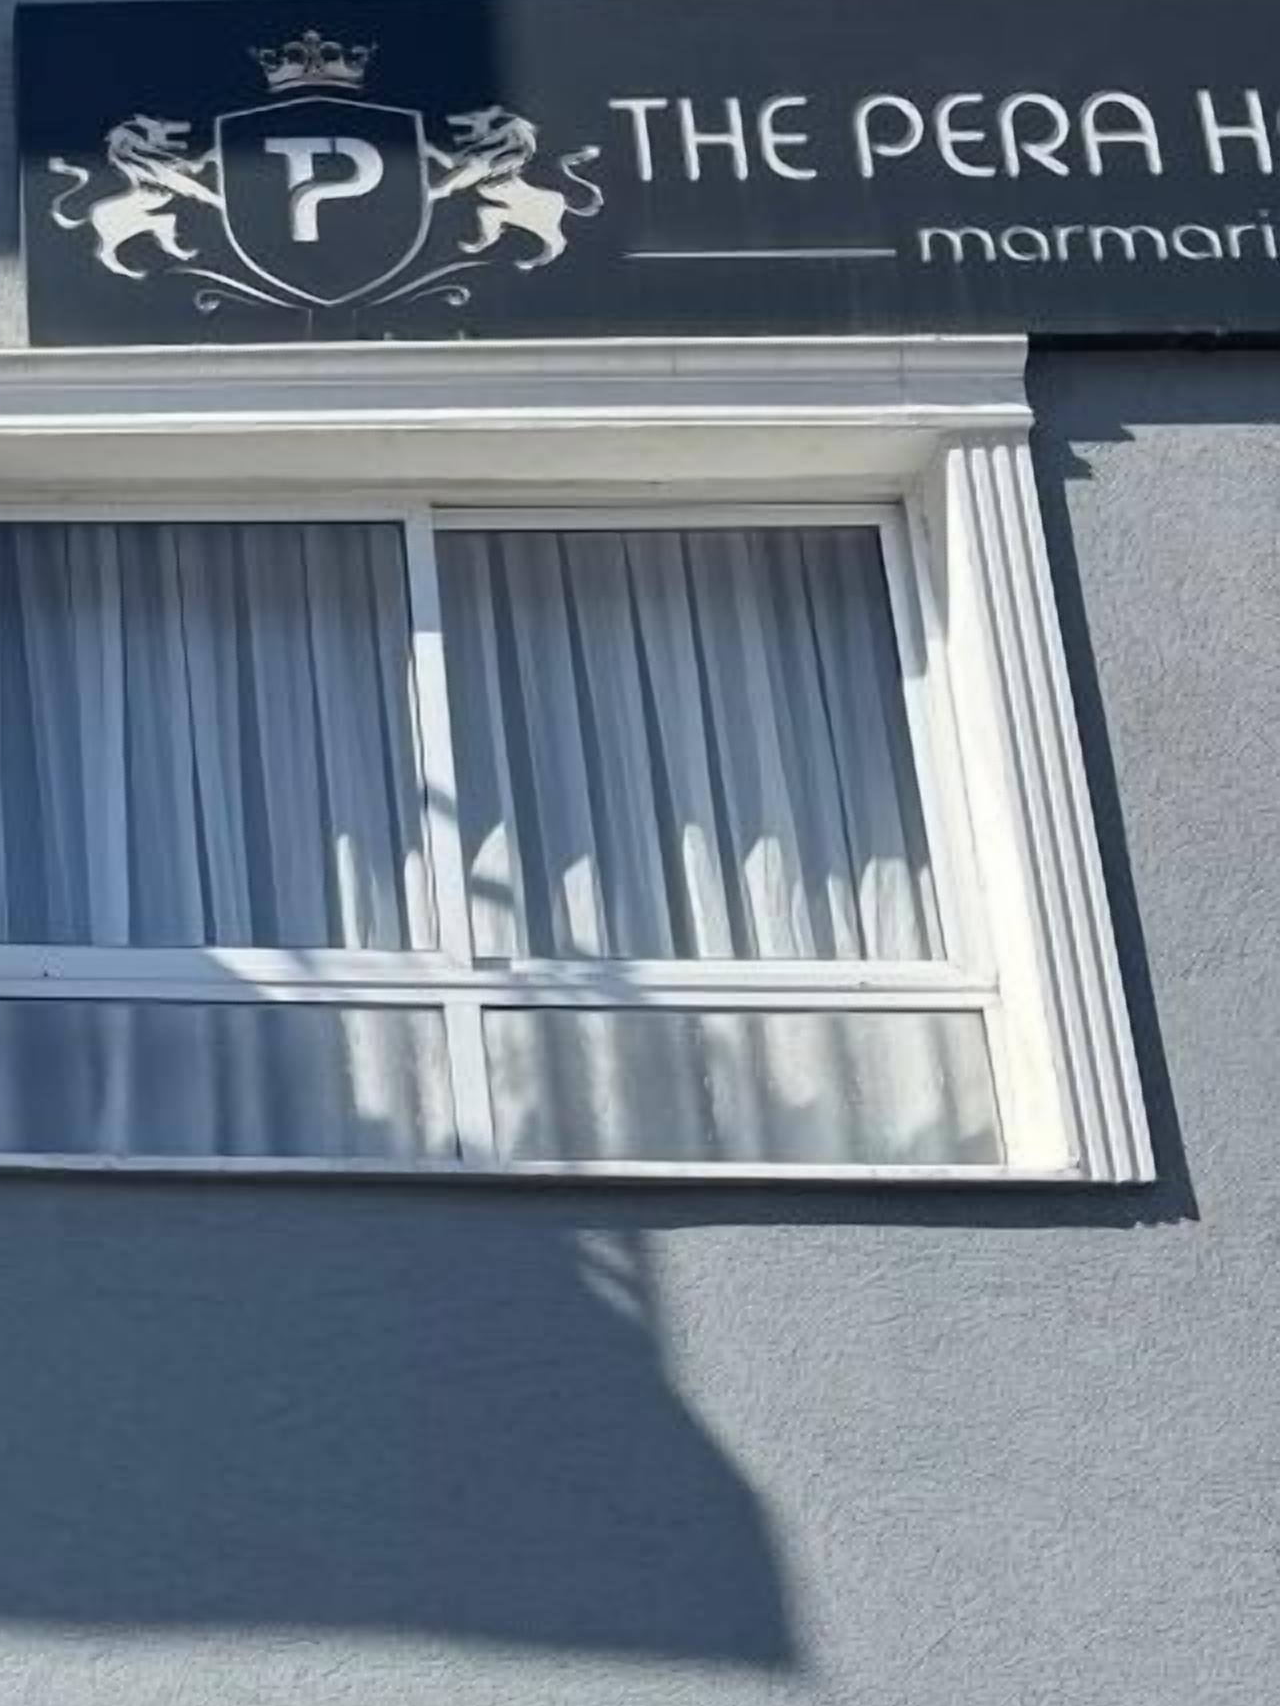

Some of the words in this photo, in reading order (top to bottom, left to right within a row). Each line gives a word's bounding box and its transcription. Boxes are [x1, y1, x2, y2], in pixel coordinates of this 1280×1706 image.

[608, 96, 818, 181] THE
[852, 93, 1163, 179] PERA
[1196, 88, 1280, 175] H
[918, 208, 1278, 263] marmari
